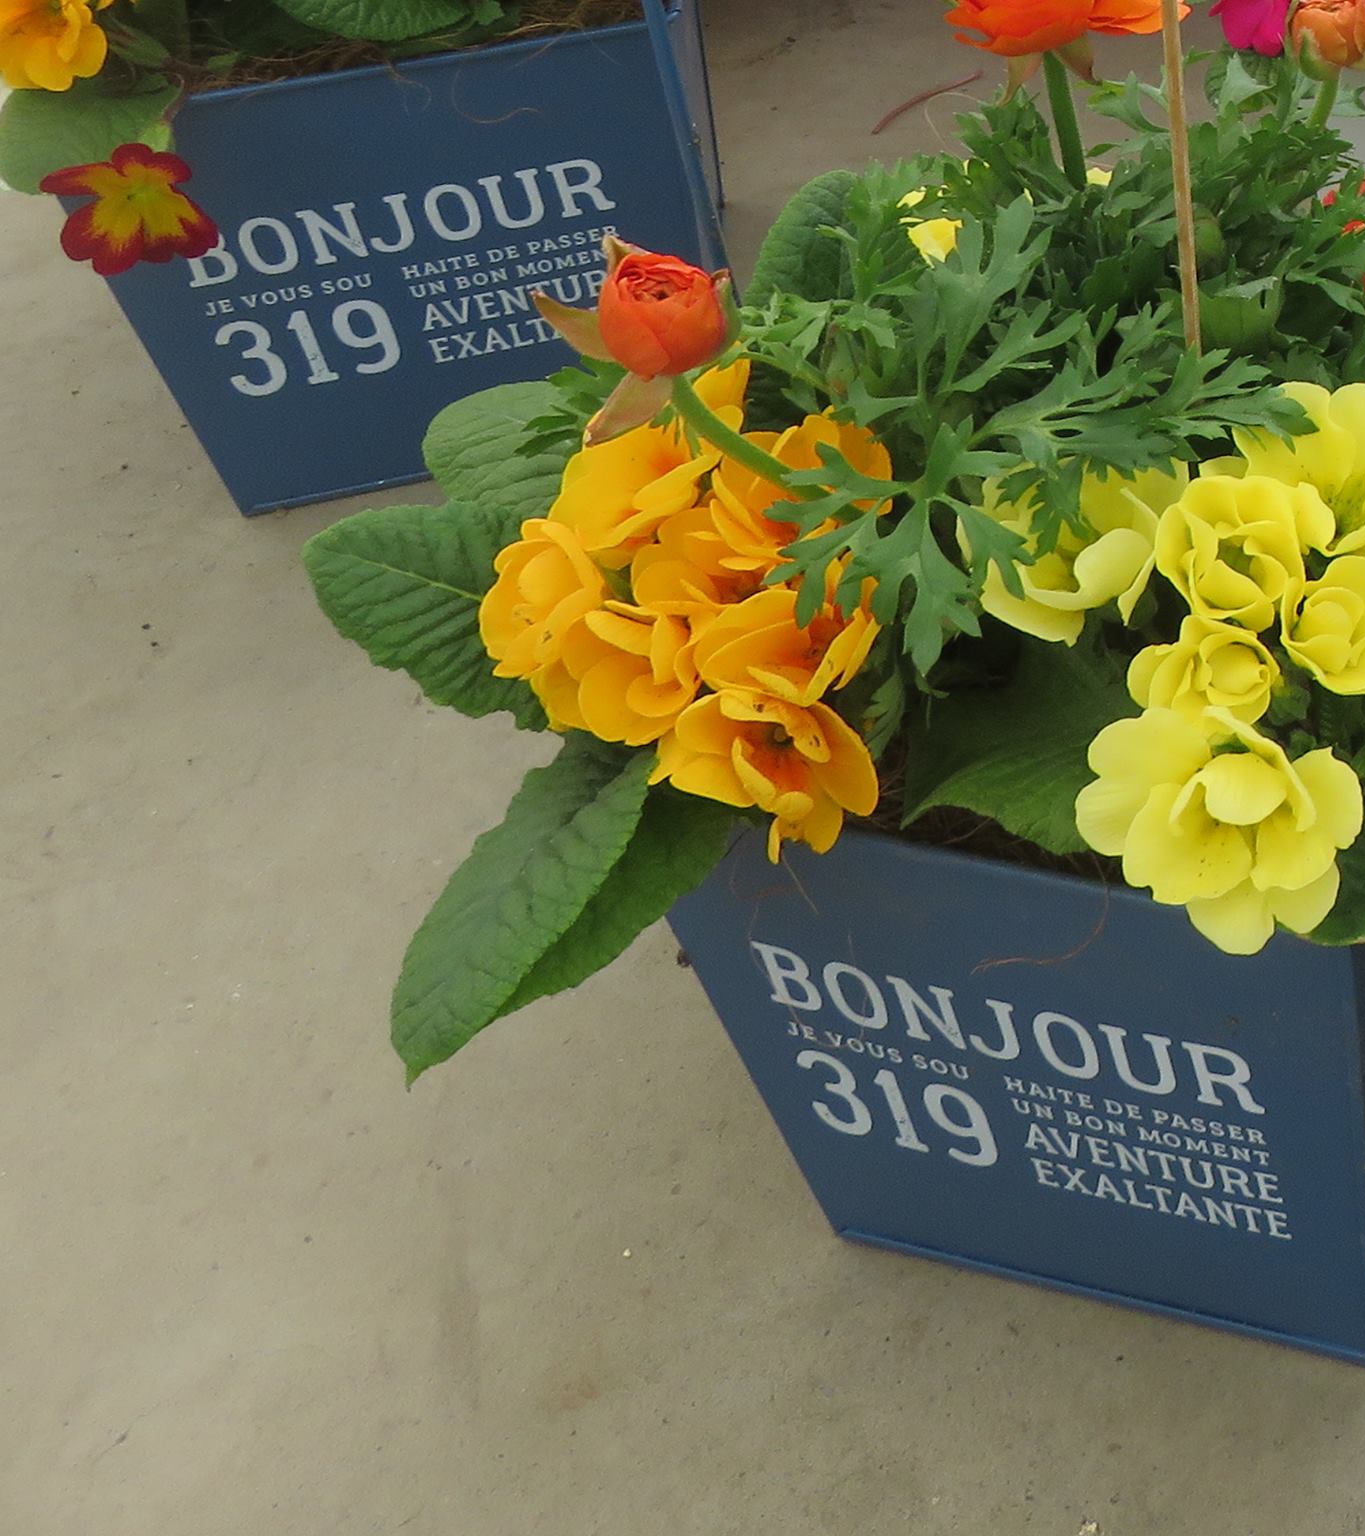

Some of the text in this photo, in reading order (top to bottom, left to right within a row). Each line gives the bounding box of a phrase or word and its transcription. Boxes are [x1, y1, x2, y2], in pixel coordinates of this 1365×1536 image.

[187, 158, 616, 290] BONJOUR
[401, 225, 620, 280] HAITE DE PASSER
[205, 273, 374, 318] JE VOUS SOU
[409, 249, 607, 298] UN BON MOMEN
[422, 270, 607, 332] AVENUR
[214, 299, 401, 397] 319
[428, 318, 564, 364] EXALT
[750, 940, 1266, 1114] BONJOUR
[787, 1021, 970, 1080] JE VOUS SOU
[796, 1049, 999, 1167] 319
[1003, 1075, 1267, 1145] HAITE DE PASSER
[1011, 1097, 1270, 1166] UN BON MOMENT
[1025, 1124, 1284, 1205] AVENTURE
[1030, 1156, 1293, 1241] EXALTANTE
